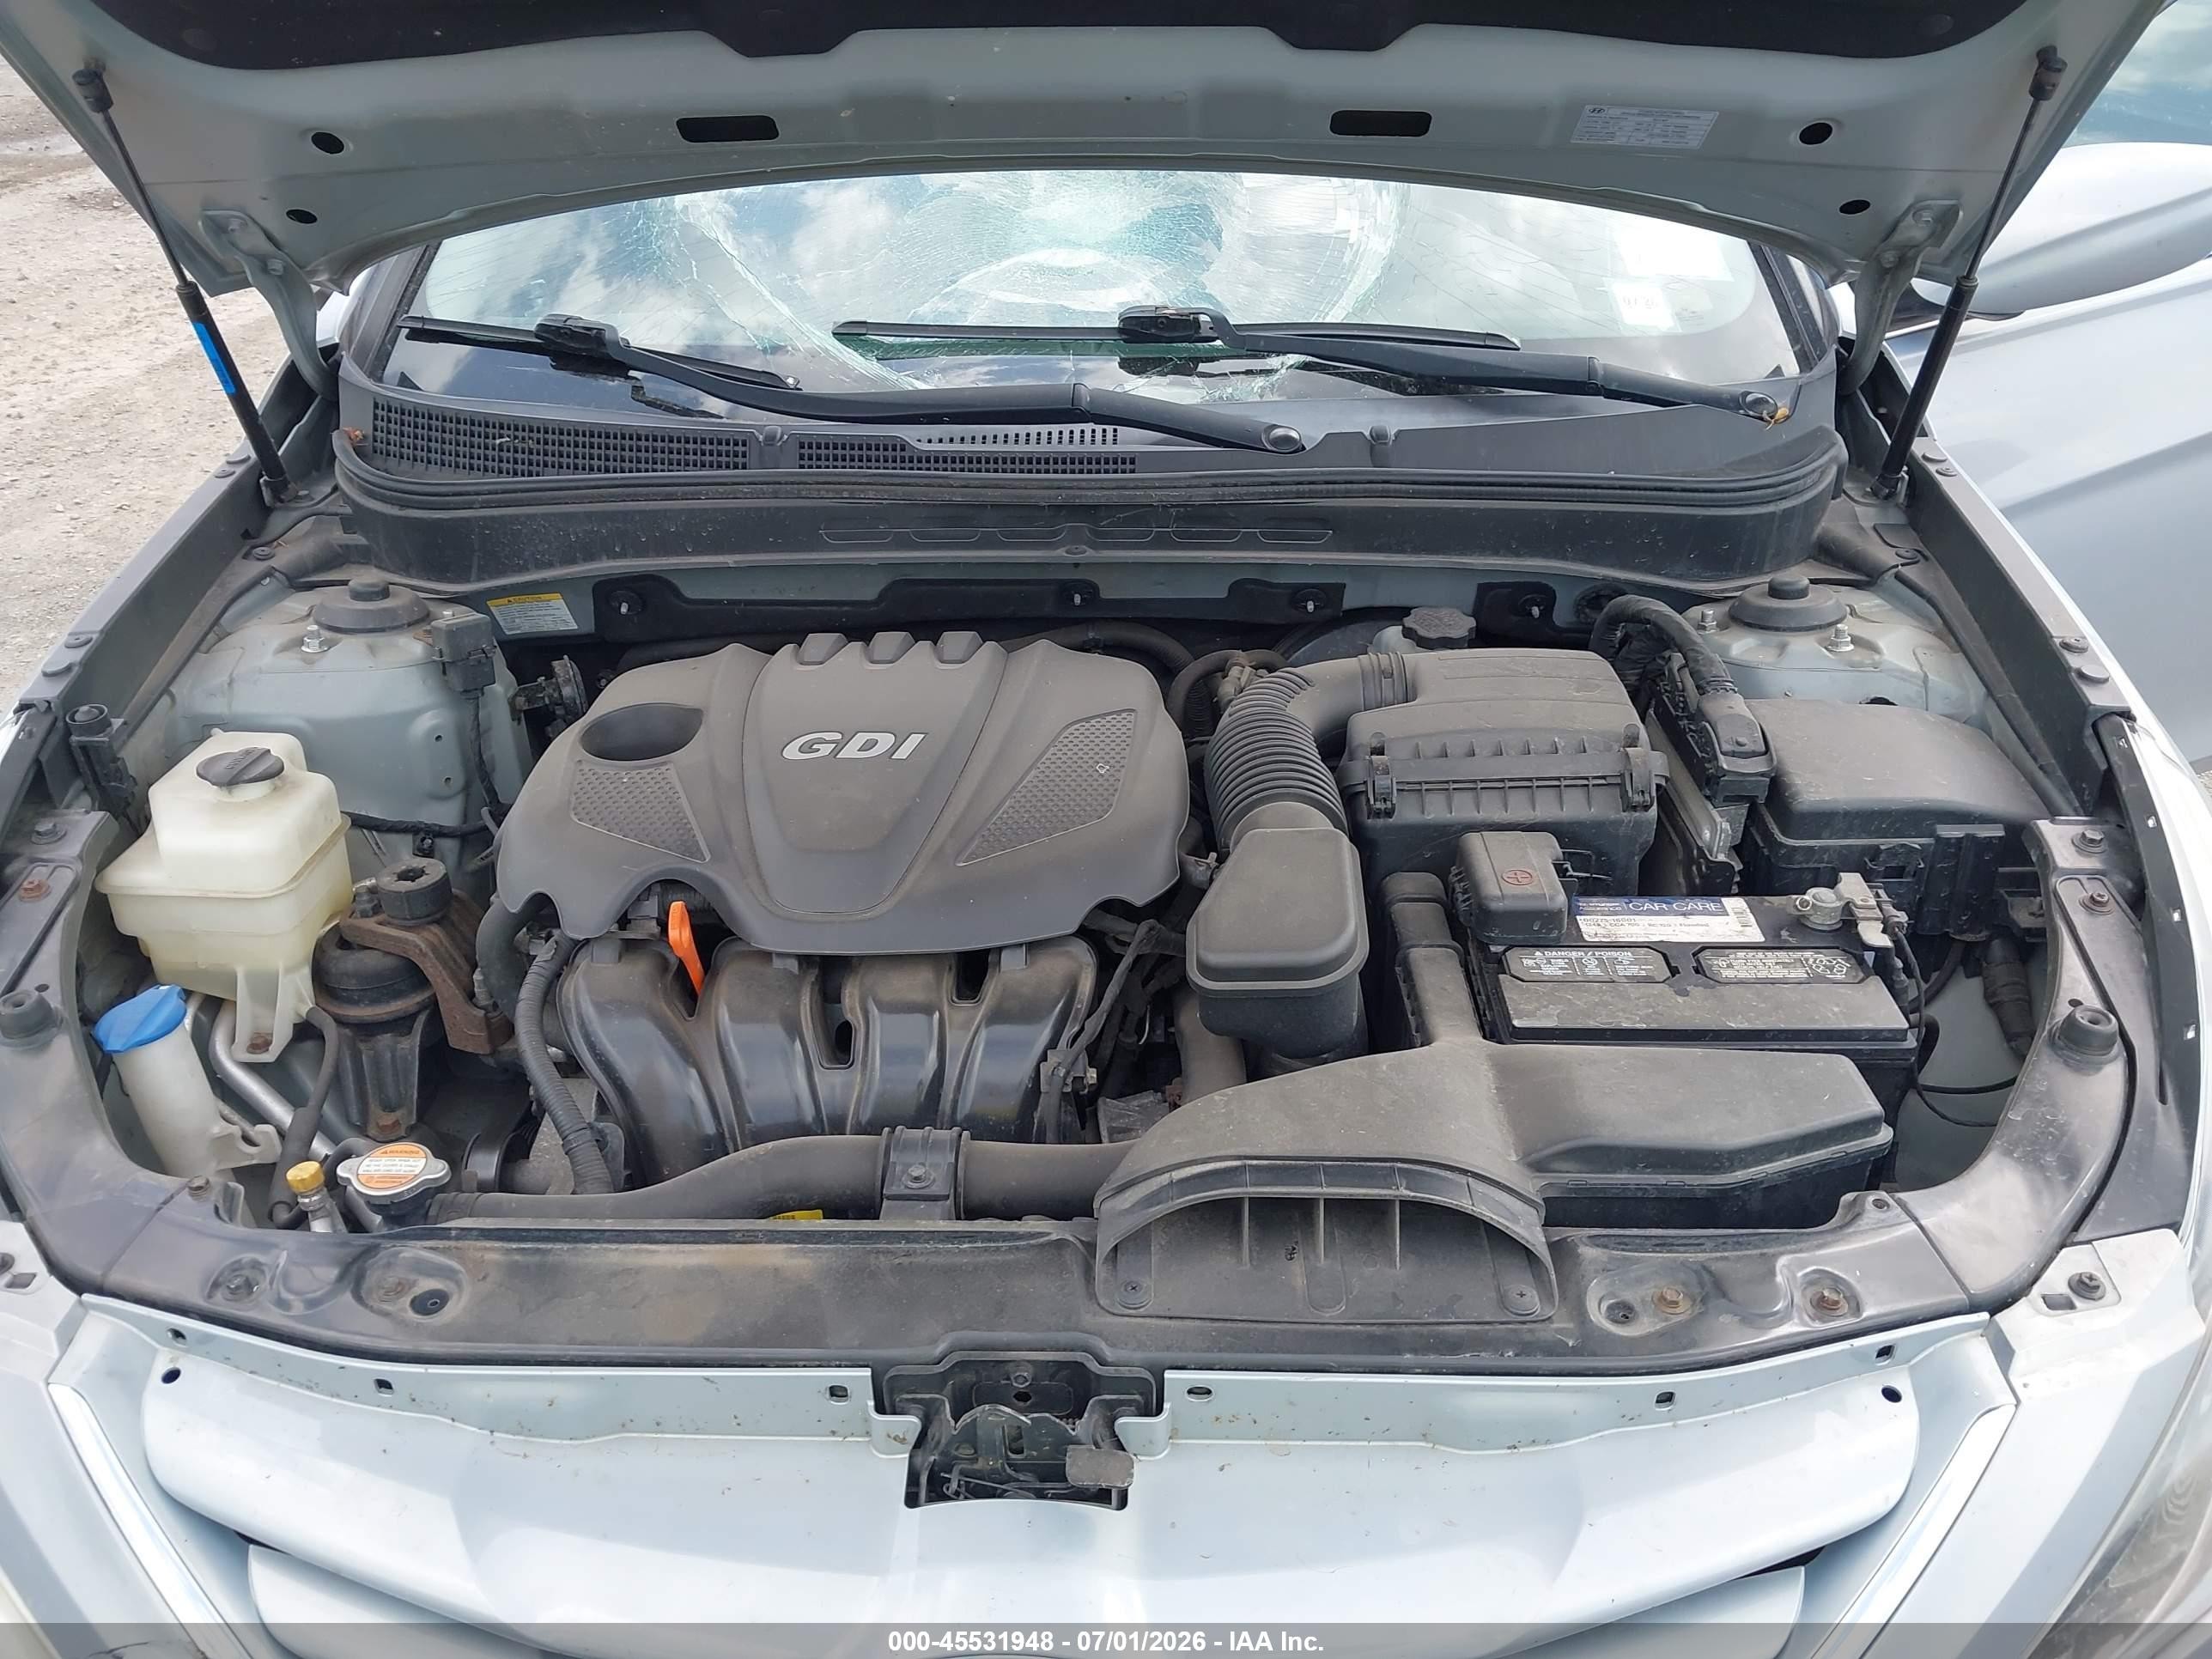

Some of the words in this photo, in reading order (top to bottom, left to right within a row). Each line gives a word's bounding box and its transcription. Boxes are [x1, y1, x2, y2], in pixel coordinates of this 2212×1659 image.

[781, 731, 929, 760] GDI
[1629, 902, 1669, 911] CAR
[1673, 902, 1723, 911] CARE
